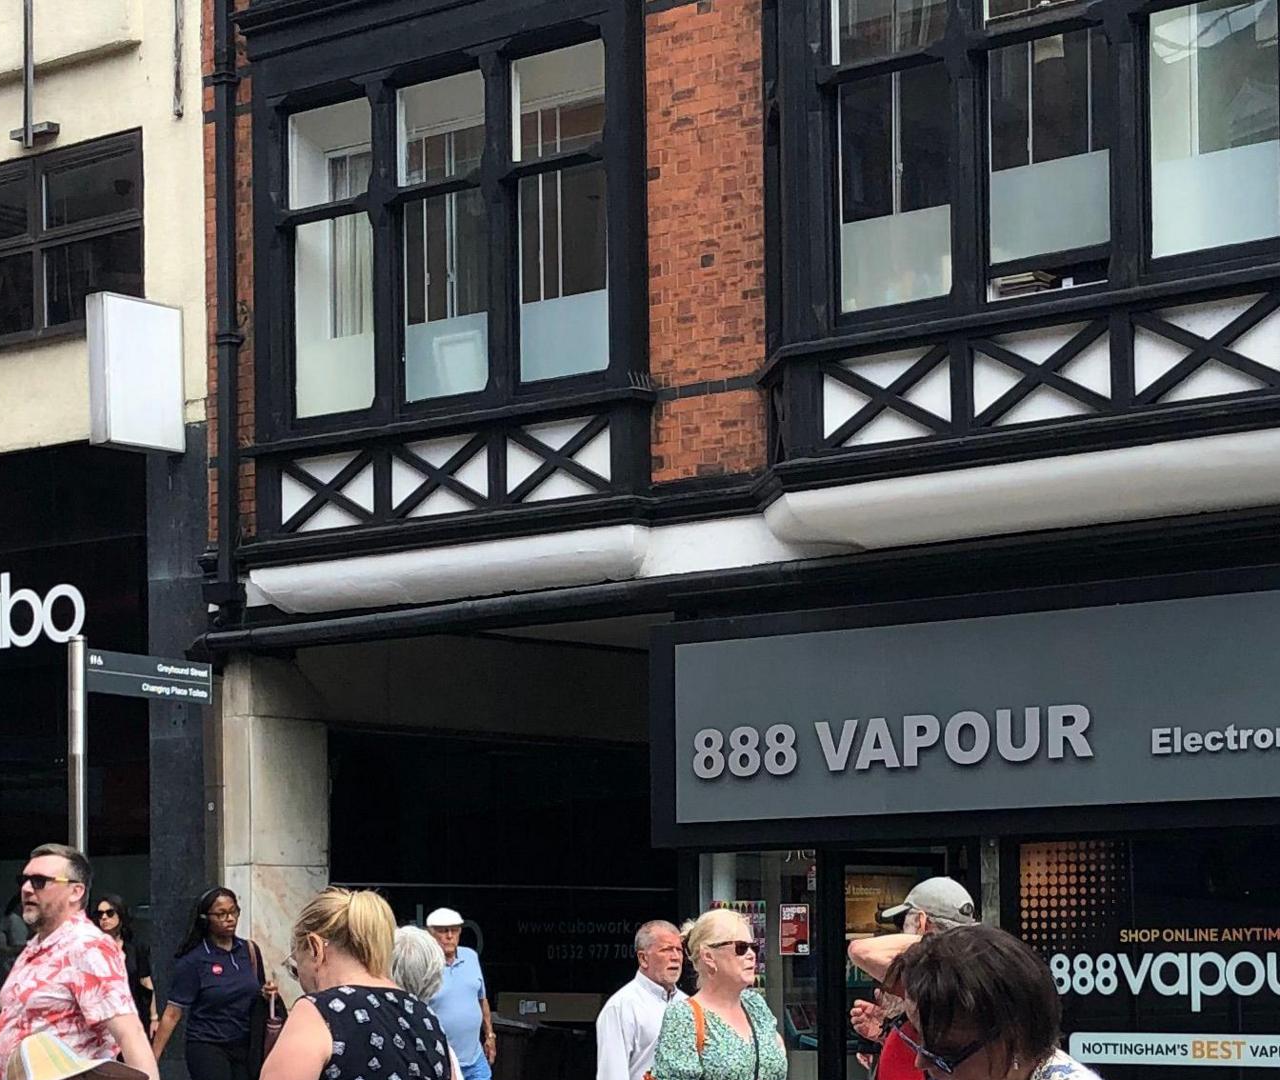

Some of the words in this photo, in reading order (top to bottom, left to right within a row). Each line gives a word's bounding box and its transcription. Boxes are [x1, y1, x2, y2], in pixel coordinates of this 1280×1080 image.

[692, 723, 798, 780] 888
[814, 704, 1095, 773] VAPOUR
[1120, 929, 1161, 943] SHOP
[1163, 929, 1219, 943] ONLINE
[1081, 1041, 1188, 1057] NOTTINGHAM'S
[1191, 1039, 1246, 1060] BEST
